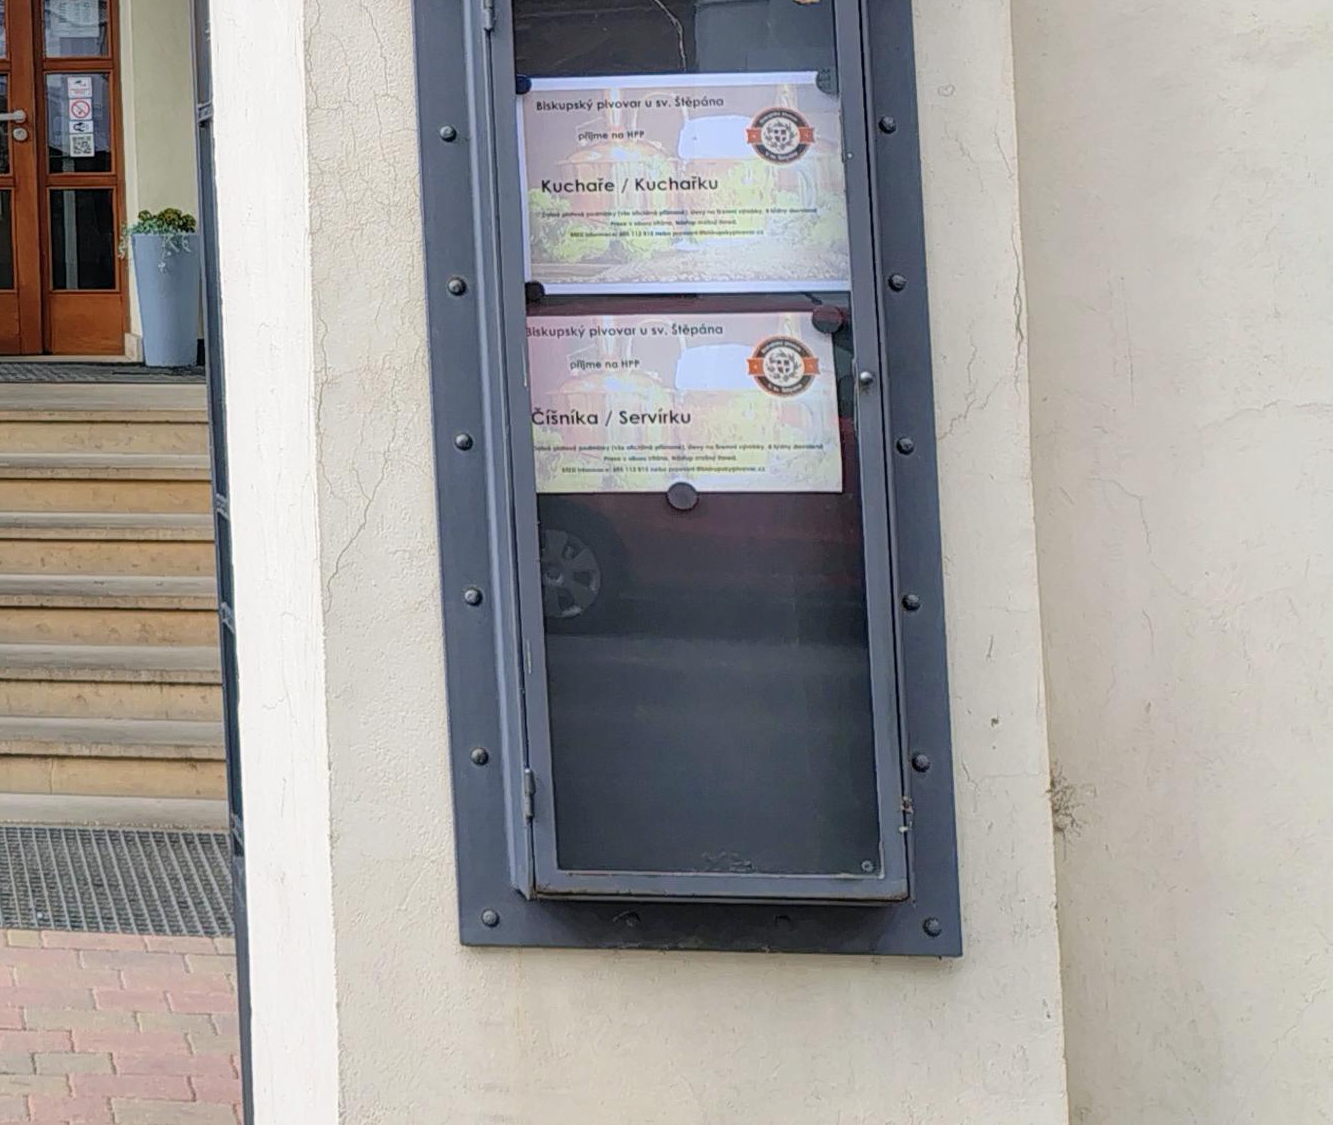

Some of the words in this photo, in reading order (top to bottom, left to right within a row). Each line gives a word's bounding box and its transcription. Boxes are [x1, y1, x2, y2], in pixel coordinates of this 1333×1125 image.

[536, 98, 593, 112] Biskupský
[597, 98, 641, 111] pivovar
[645, 100, 652, 108] u
[655, 99, 672, 108] sv.
[674, 96, 724, 109] Štěpána
[611, 131, 624, 140] na
[541, 177, 616, 194] Kuchaře
[635, 176, 718, 192] Kuchařku
[526, 326, 586, 339] Biskupský
[589, 325, 636, 338] pivovar
[640, 327, 648, 336] u
[651, 326, 668, 336] sv.
[671, 323, 723, 337] Štěpána
[604, 361, 618, 369] na
[531, 406, 599, 426] Číšníka
[619, 408, 692, 425] Servírku
